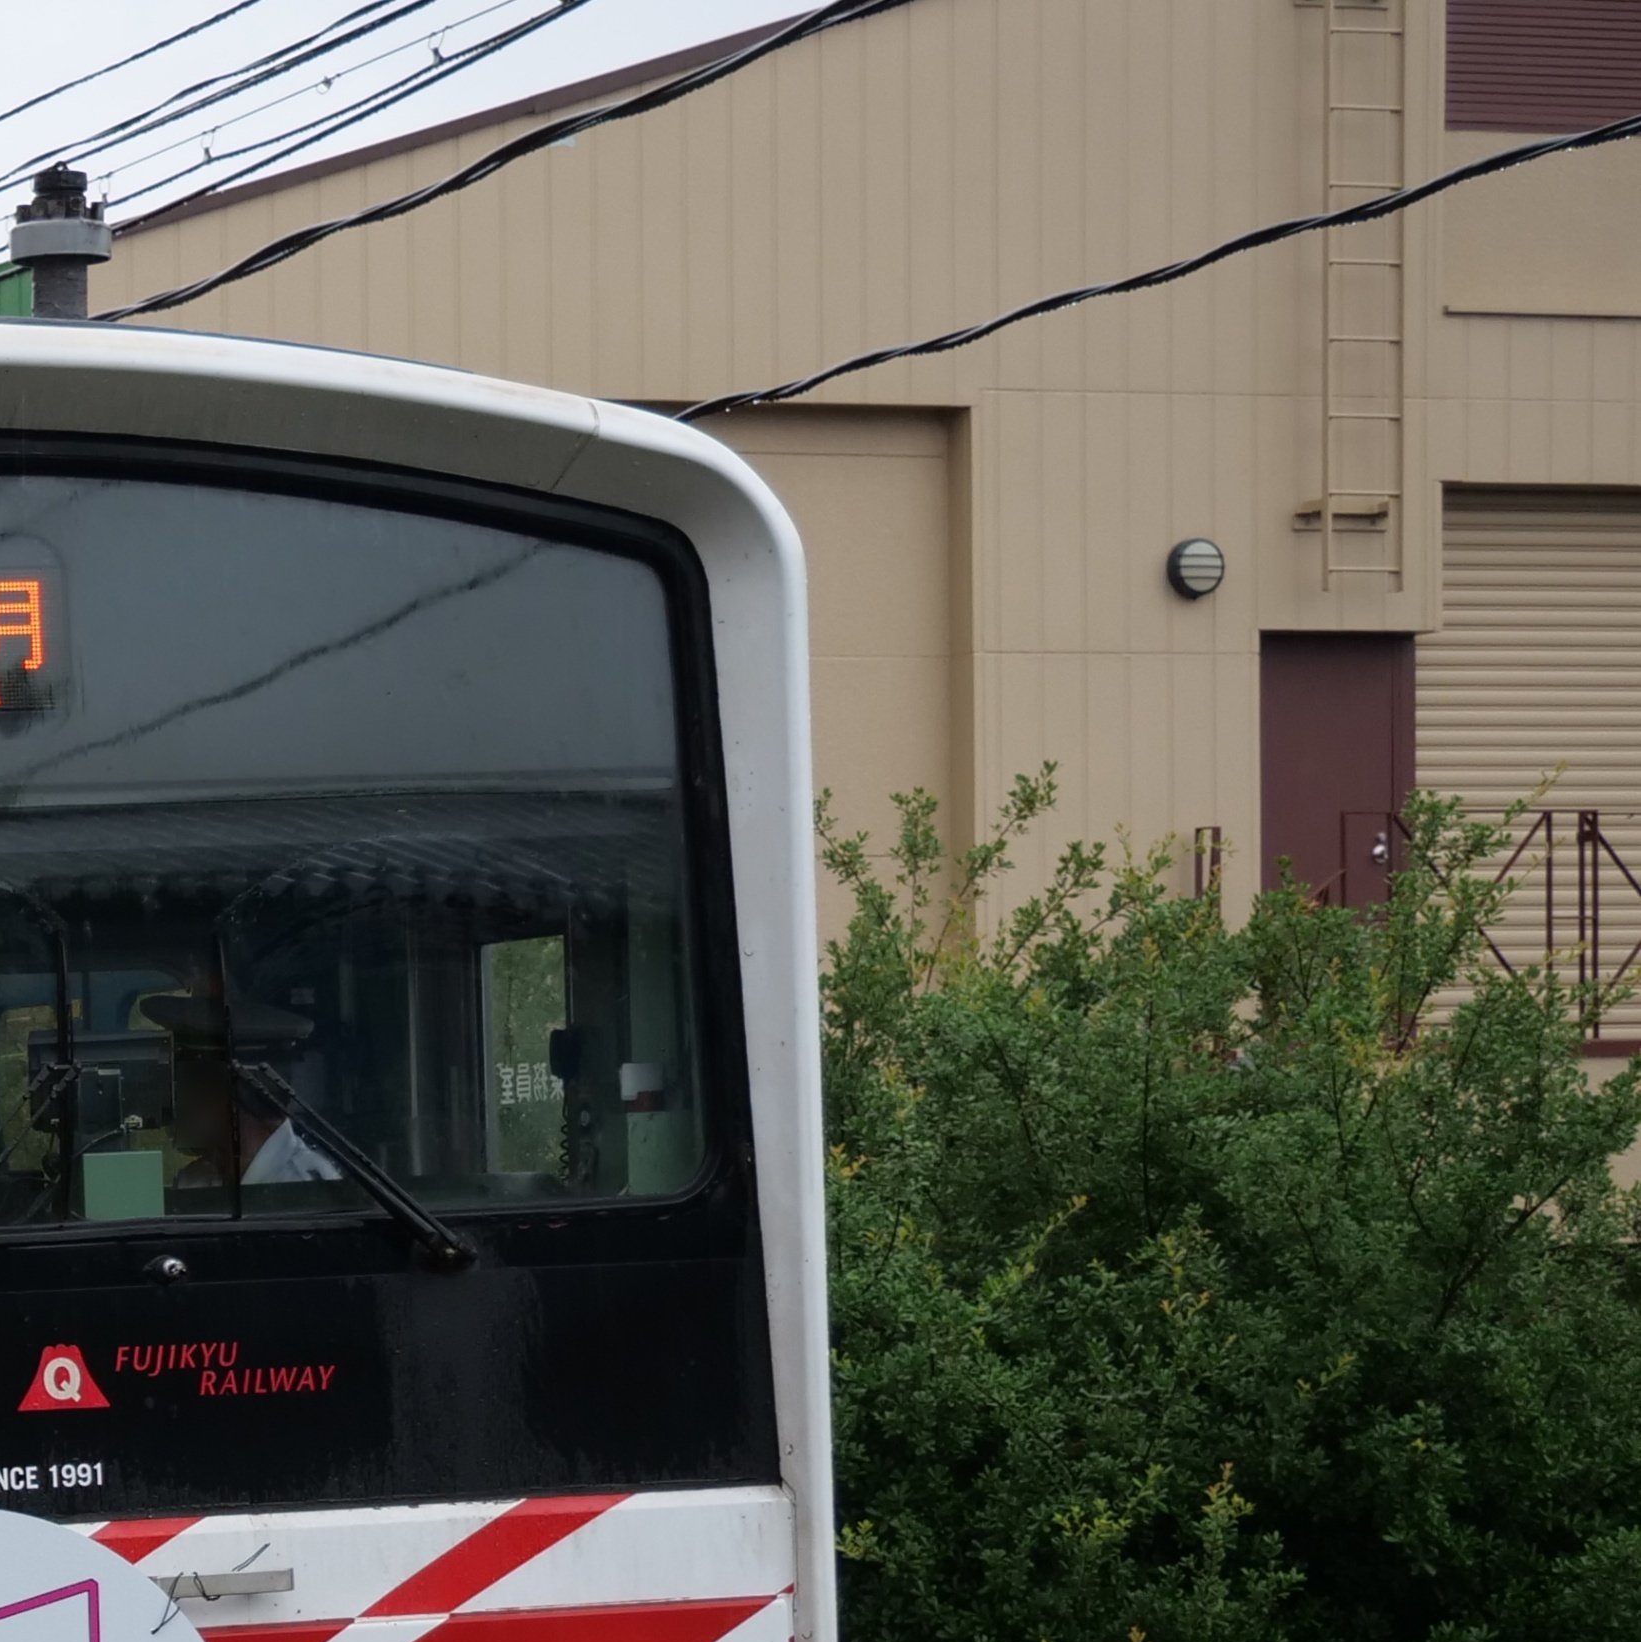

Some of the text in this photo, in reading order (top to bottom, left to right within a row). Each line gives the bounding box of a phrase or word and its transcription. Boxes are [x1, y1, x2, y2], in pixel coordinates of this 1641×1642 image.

[115, 1342, 238, 1376] FUJIKYU
[200, 1365, 335, 1395] RAILWAY
[48, 1462, 104, 1489] 1991
